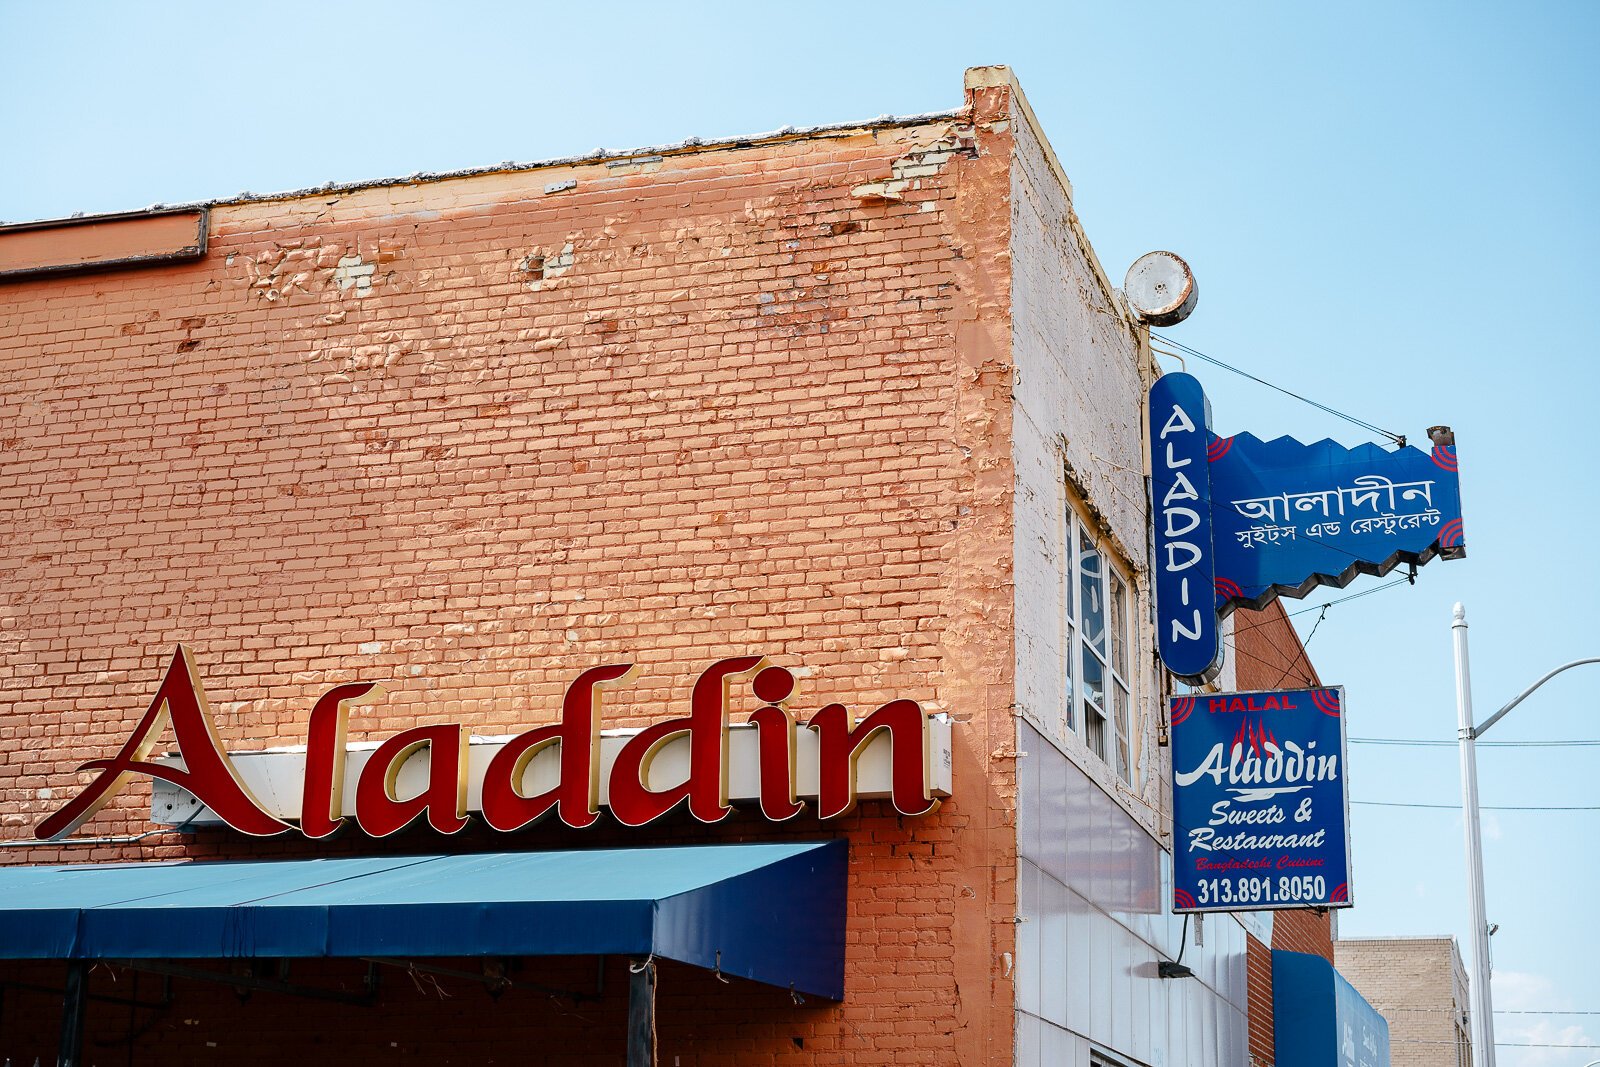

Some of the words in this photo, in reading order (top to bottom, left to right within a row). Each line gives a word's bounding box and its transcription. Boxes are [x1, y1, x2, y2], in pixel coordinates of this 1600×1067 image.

[1230, 475, 1436, 522] আলাদীন
[1160, 404, 1202, 643] ALADDIN
[1209, 695, 1297, 713] HALAL
[34, 643, 942, 841] Aladdin
[1175, 740, 1338, 787] Aladdin
[1208, 800, 1286, 826] Sweets
[1294, 797, 1313, 822] &
[1188, 827, 1326, 853] Restaurant
[1195, 856, 1272, 874] Bangladeshi
[1276, 854, 1325, 871] Cuisine
[1197, 875, 1326, 904] 313.891.8050
